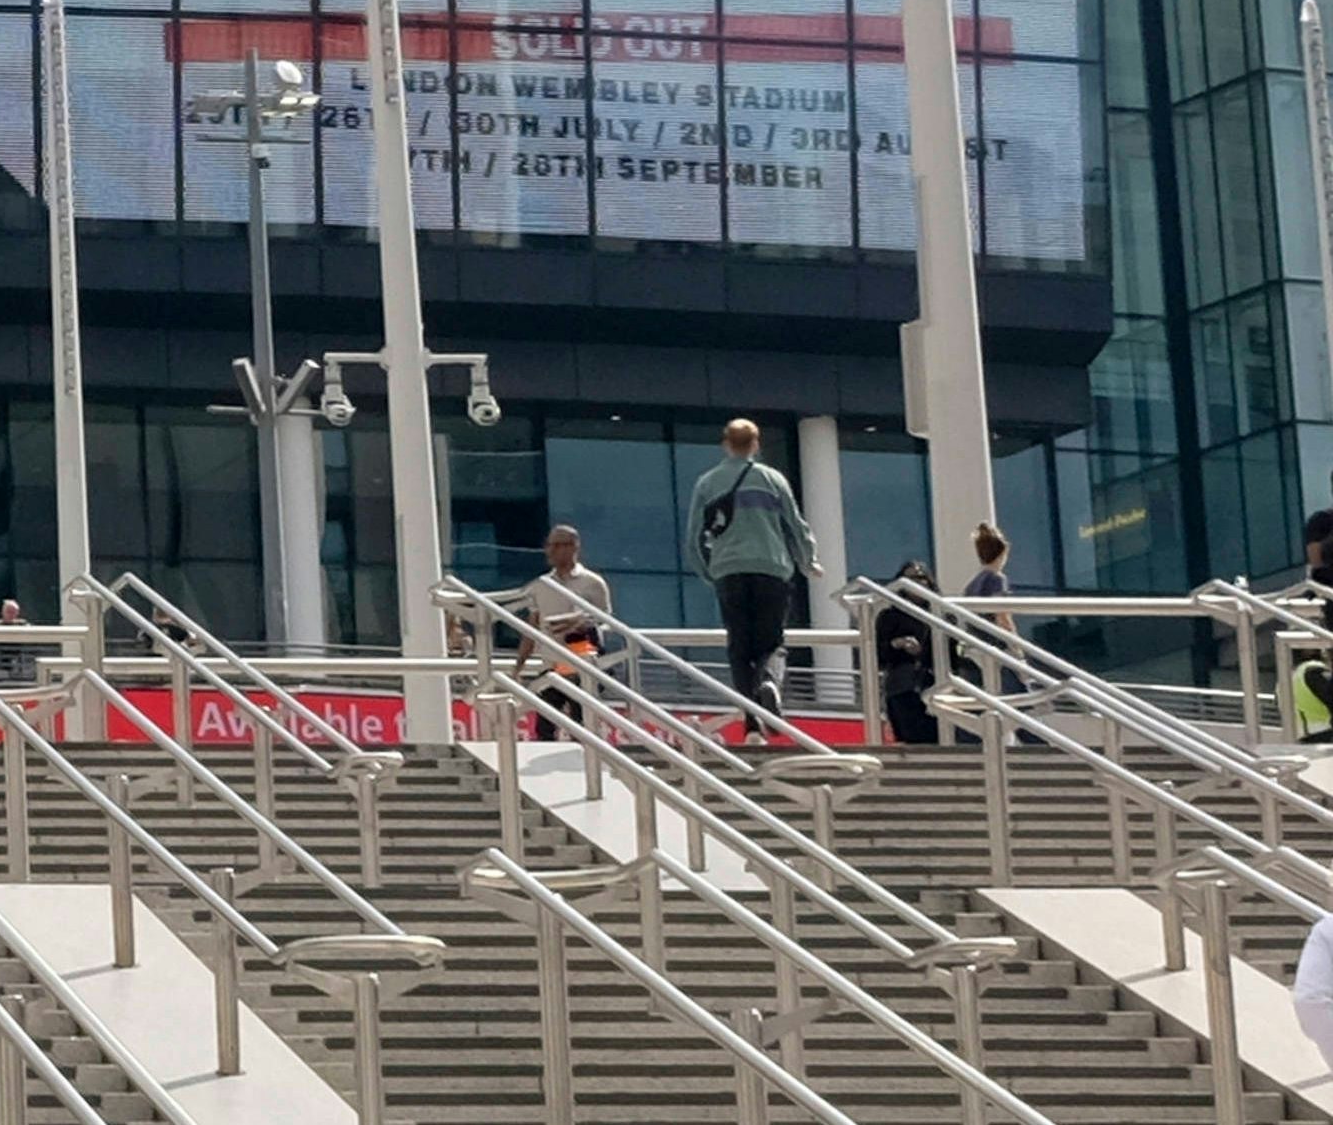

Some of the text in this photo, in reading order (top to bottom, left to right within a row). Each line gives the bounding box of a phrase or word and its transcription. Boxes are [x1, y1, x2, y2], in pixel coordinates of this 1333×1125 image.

[490, 16, 708, 61] SOLD OUT
[351, 68, 847, 113] LNDON WEMBLEY STADIUM
[454, 111, 540, 138] 30TH
[553, 115, 639, 142] JULY
[679, 122, 753, 149] 2ND
[790, 127, 863, 154] 3RD
[873, 131, 1009, 162] AUST
[515, 153, 605, 179] 28TH
[616, 157, 824, 190] SEPTEMBER
